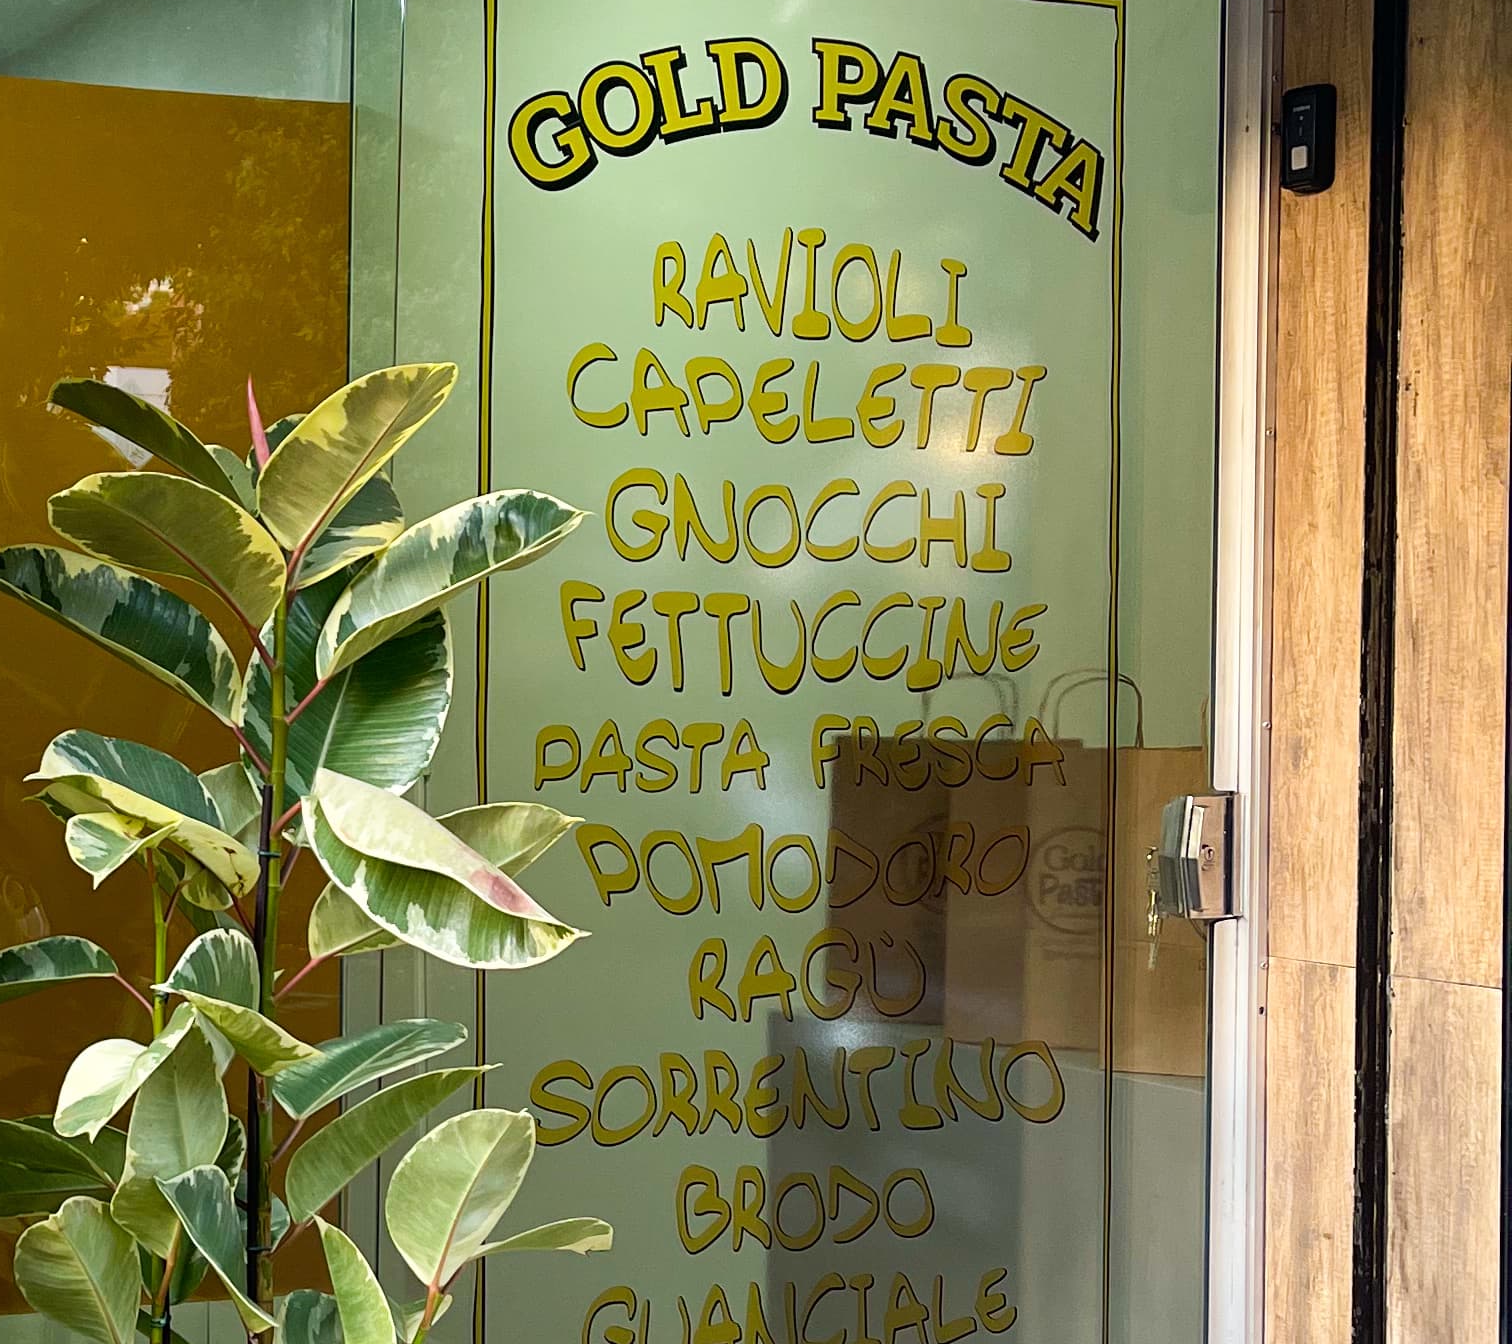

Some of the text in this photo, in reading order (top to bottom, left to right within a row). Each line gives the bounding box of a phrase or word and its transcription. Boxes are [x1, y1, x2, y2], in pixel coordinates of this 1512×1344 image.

[507, 36, 1107, 243] GOLD PASTA
[652, 225, 974, 348] RAVIOLI
[565, 342, 1049, 457] CAPELETTI
[604, 467, 1013, 574] GNOCCHI
[559, 579, 1049, 697] FETTUCCINE
[533, 713, 1069, 794] PASTA FRESCA
[575, 820, 1031, 916] POMODORO
[1039, 873, 1104, 907] Past
[529, 1038, 1066, 1148] SORRENTINO
[676, 1163, 936, 1255] BRODO
